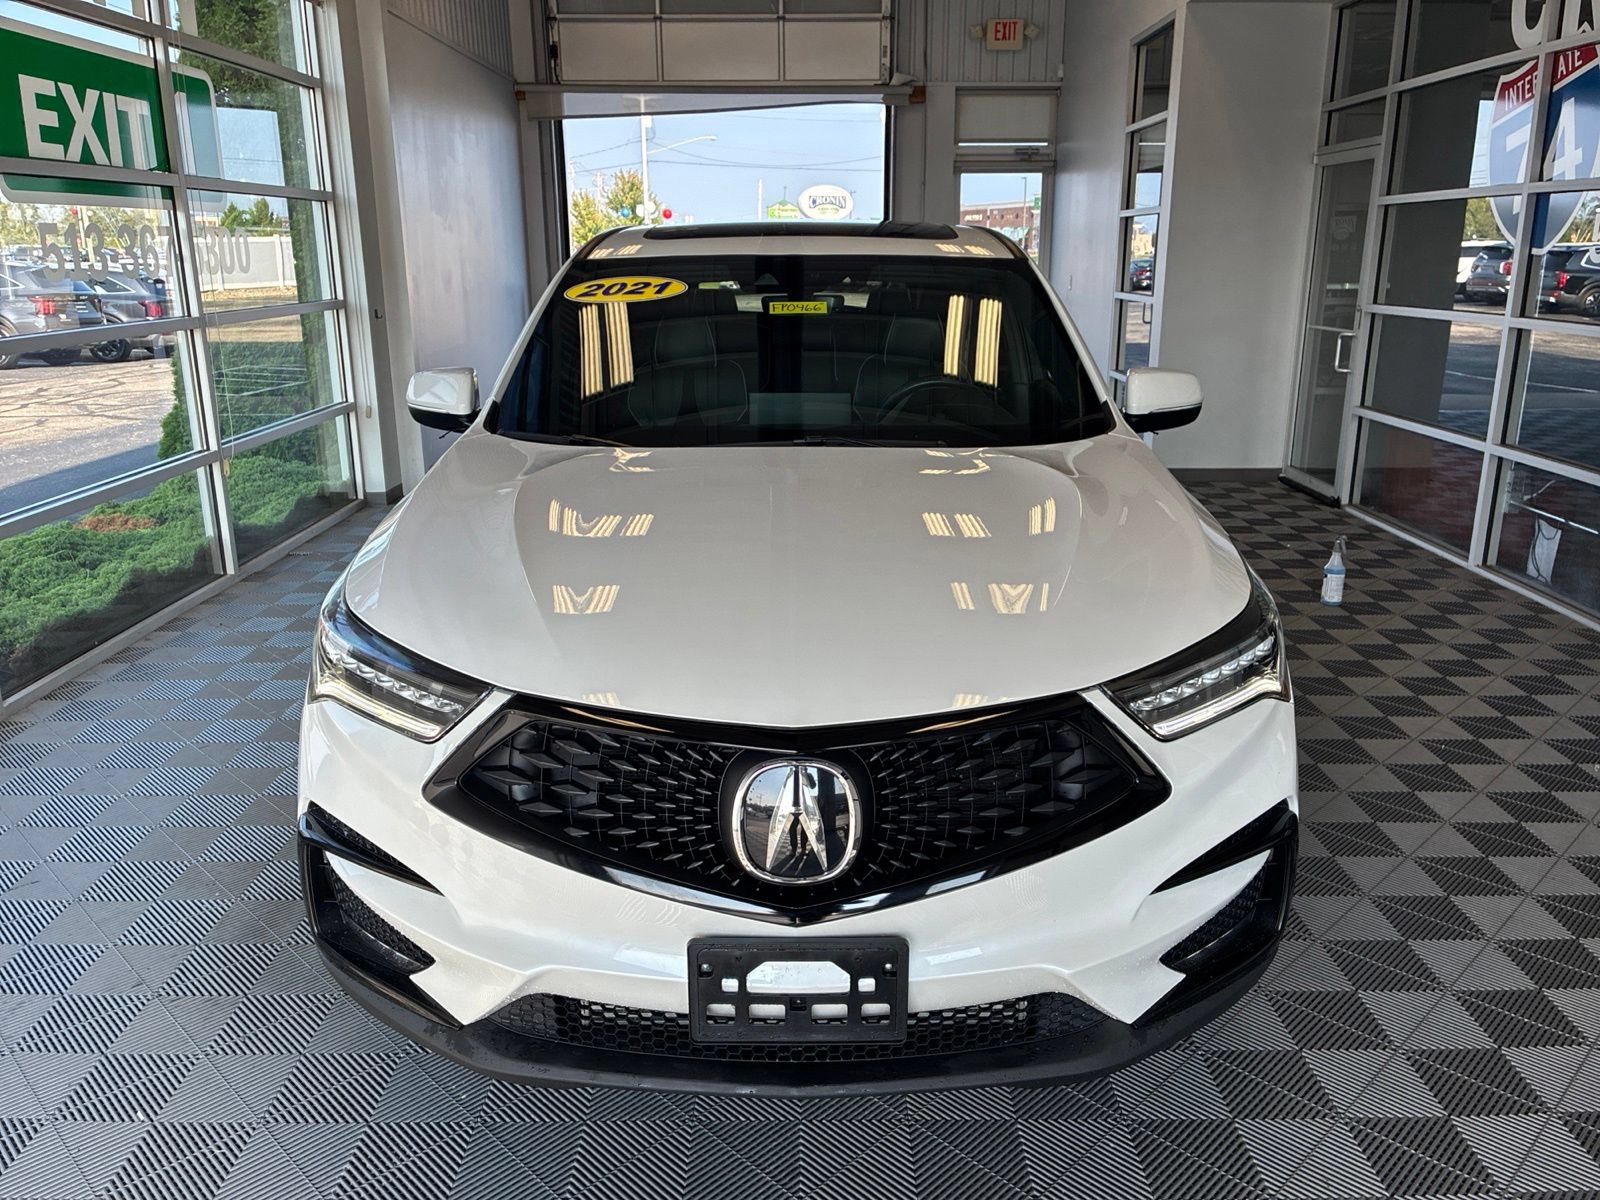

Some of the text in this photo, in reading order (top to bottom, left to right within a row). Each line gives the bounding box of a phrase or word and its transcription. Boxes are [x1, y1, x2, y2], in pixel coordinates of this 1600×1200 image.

[993, 21, 1018, 41] EXIT
[18, 73, 150, 170] EXIT
[1506, 97, 1583, 215] 74
[808, 195, 847, 209] CRONIN
[575, 281, 673, 298] 2021
